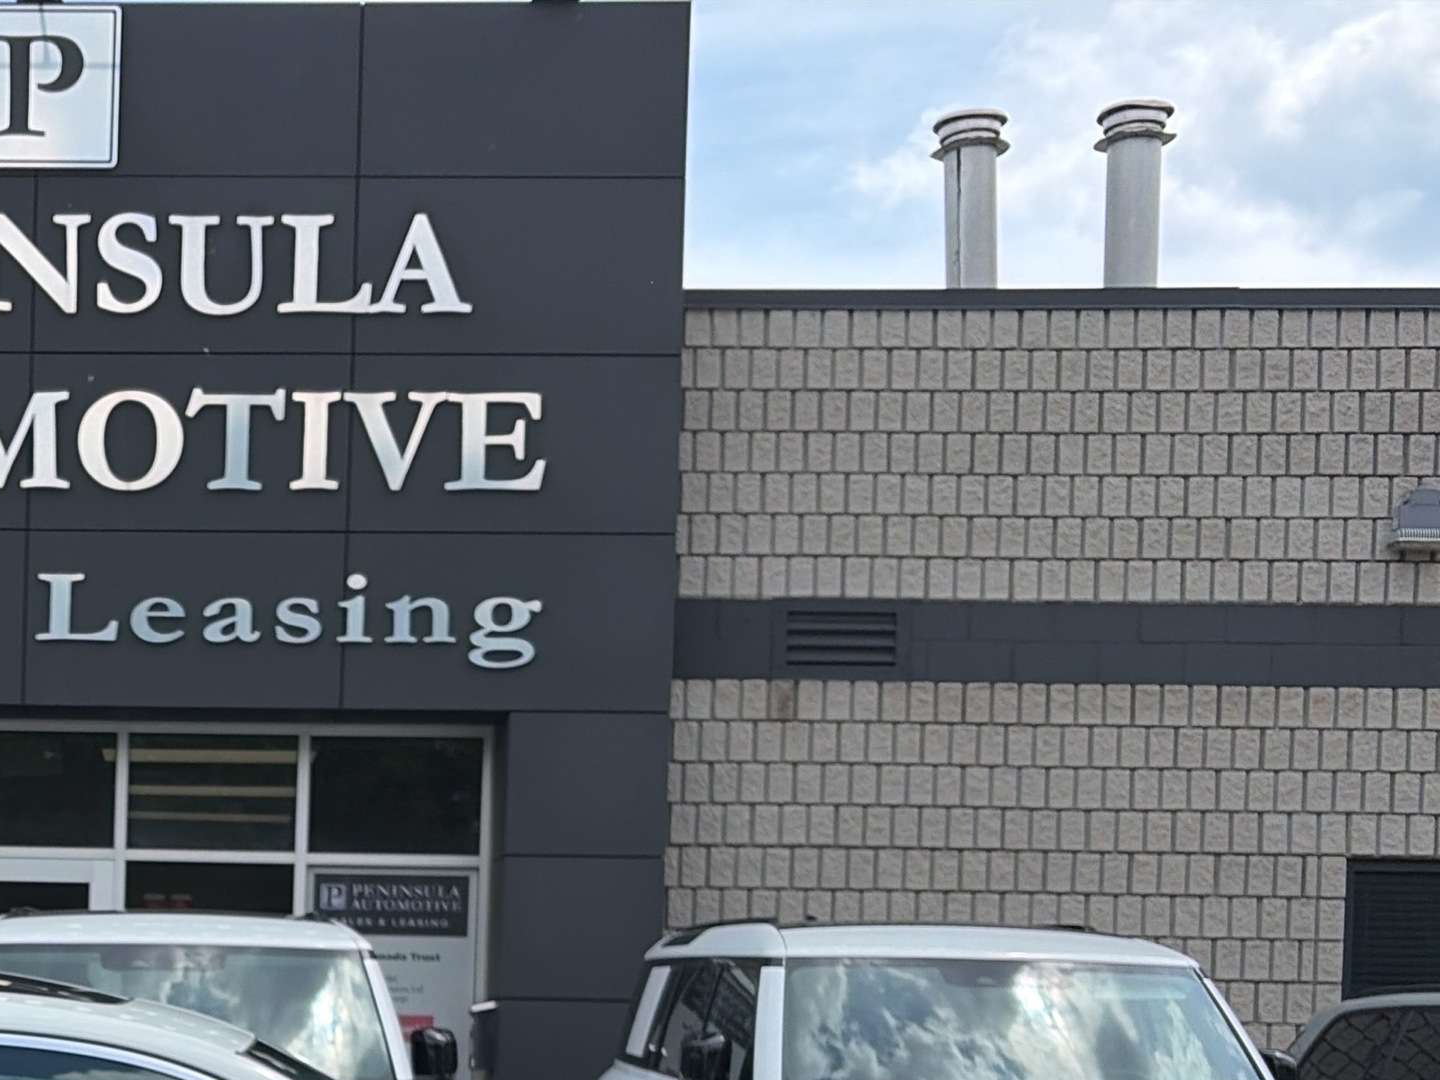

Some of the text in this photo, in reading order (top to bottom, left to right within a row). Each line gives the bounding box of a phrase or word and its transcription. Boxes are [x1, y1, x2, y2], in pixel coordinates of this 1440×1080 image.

[34, 572, 543, 669] Leasing
[326, 885, 342, 908] P
[352, 883, 460, 898] PENINSULA
[352, 899, 462, 912] AUTOMOTIVE
[391, 917, 449, 928] LEASING
[410, 952, 440, 962] Trust
